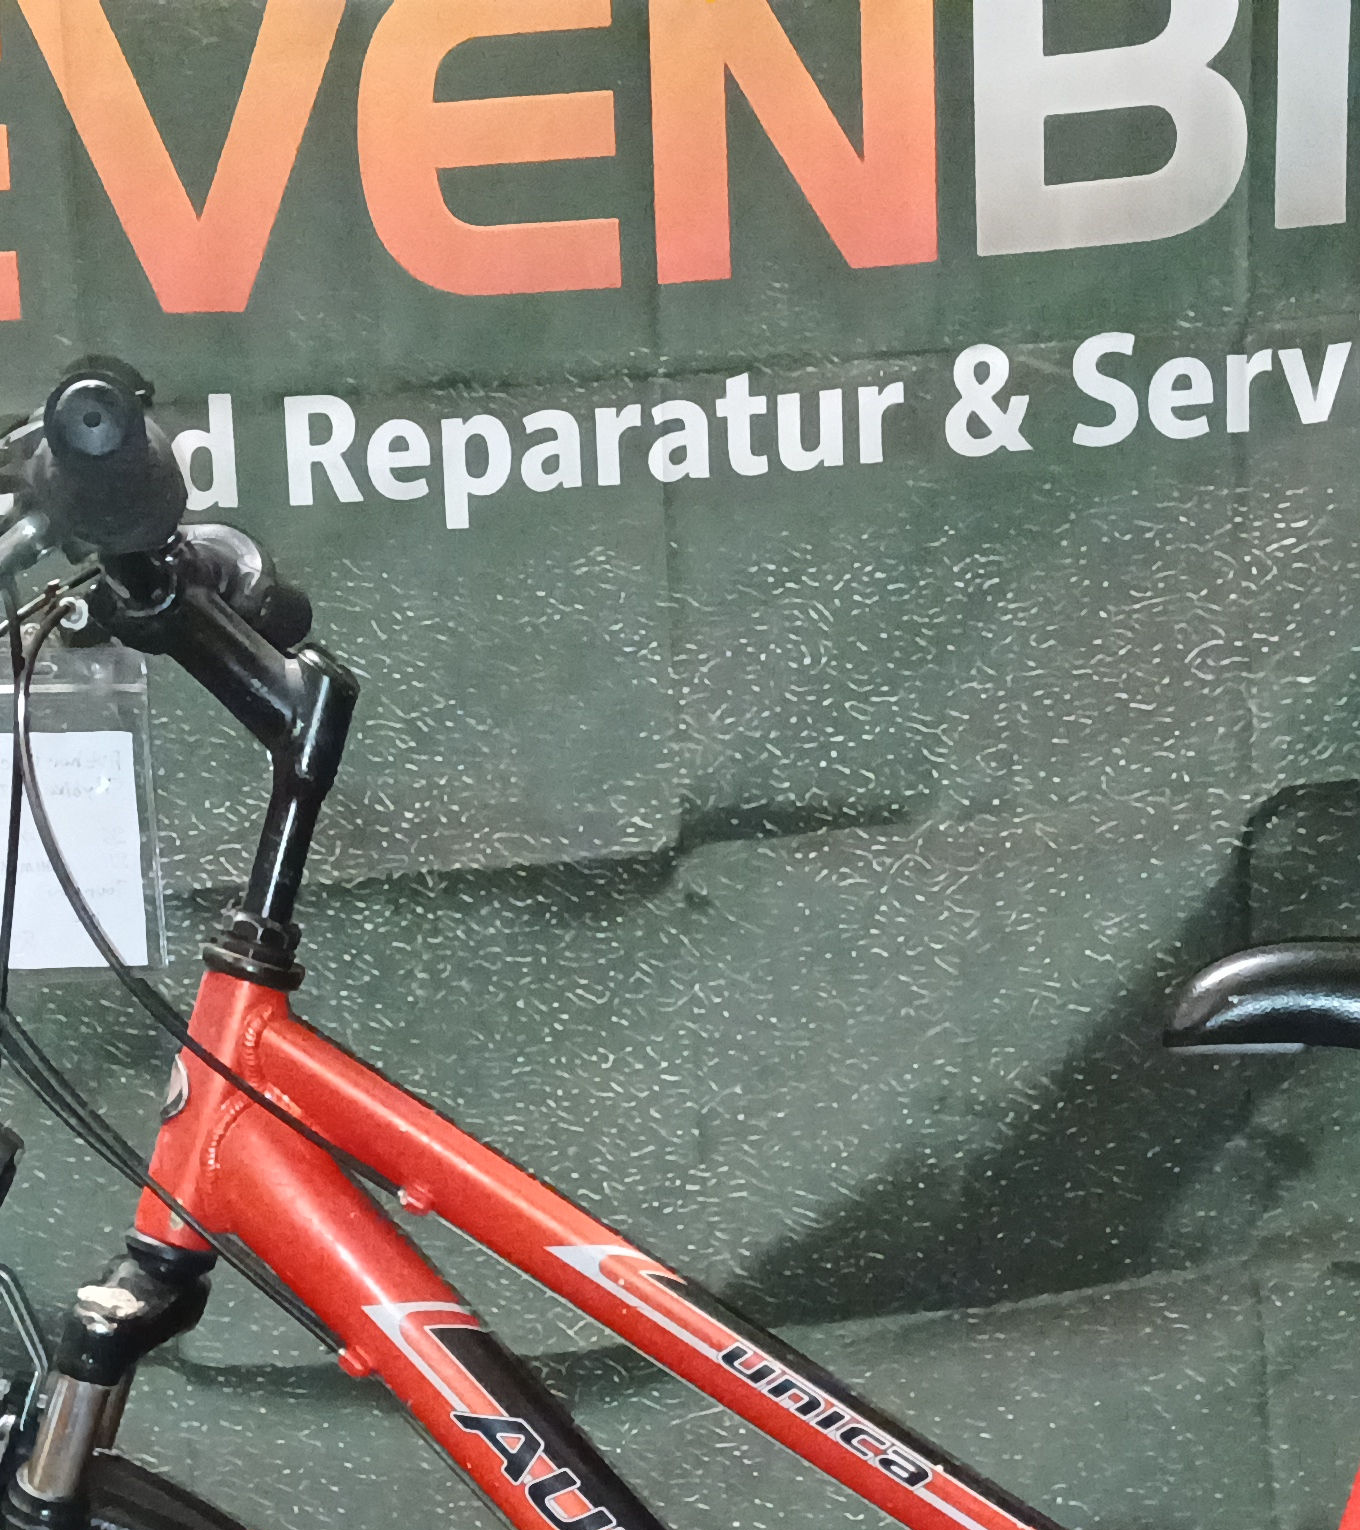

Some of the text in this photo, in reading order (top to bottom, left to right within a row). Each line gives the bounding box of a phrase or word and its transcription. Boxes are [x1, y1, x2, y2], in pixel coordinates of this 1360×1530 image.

[283, 372, 905, 530] Reparatur
[944, 343, 1034, 458] &
[718, 1341, 933, 1491] unica
